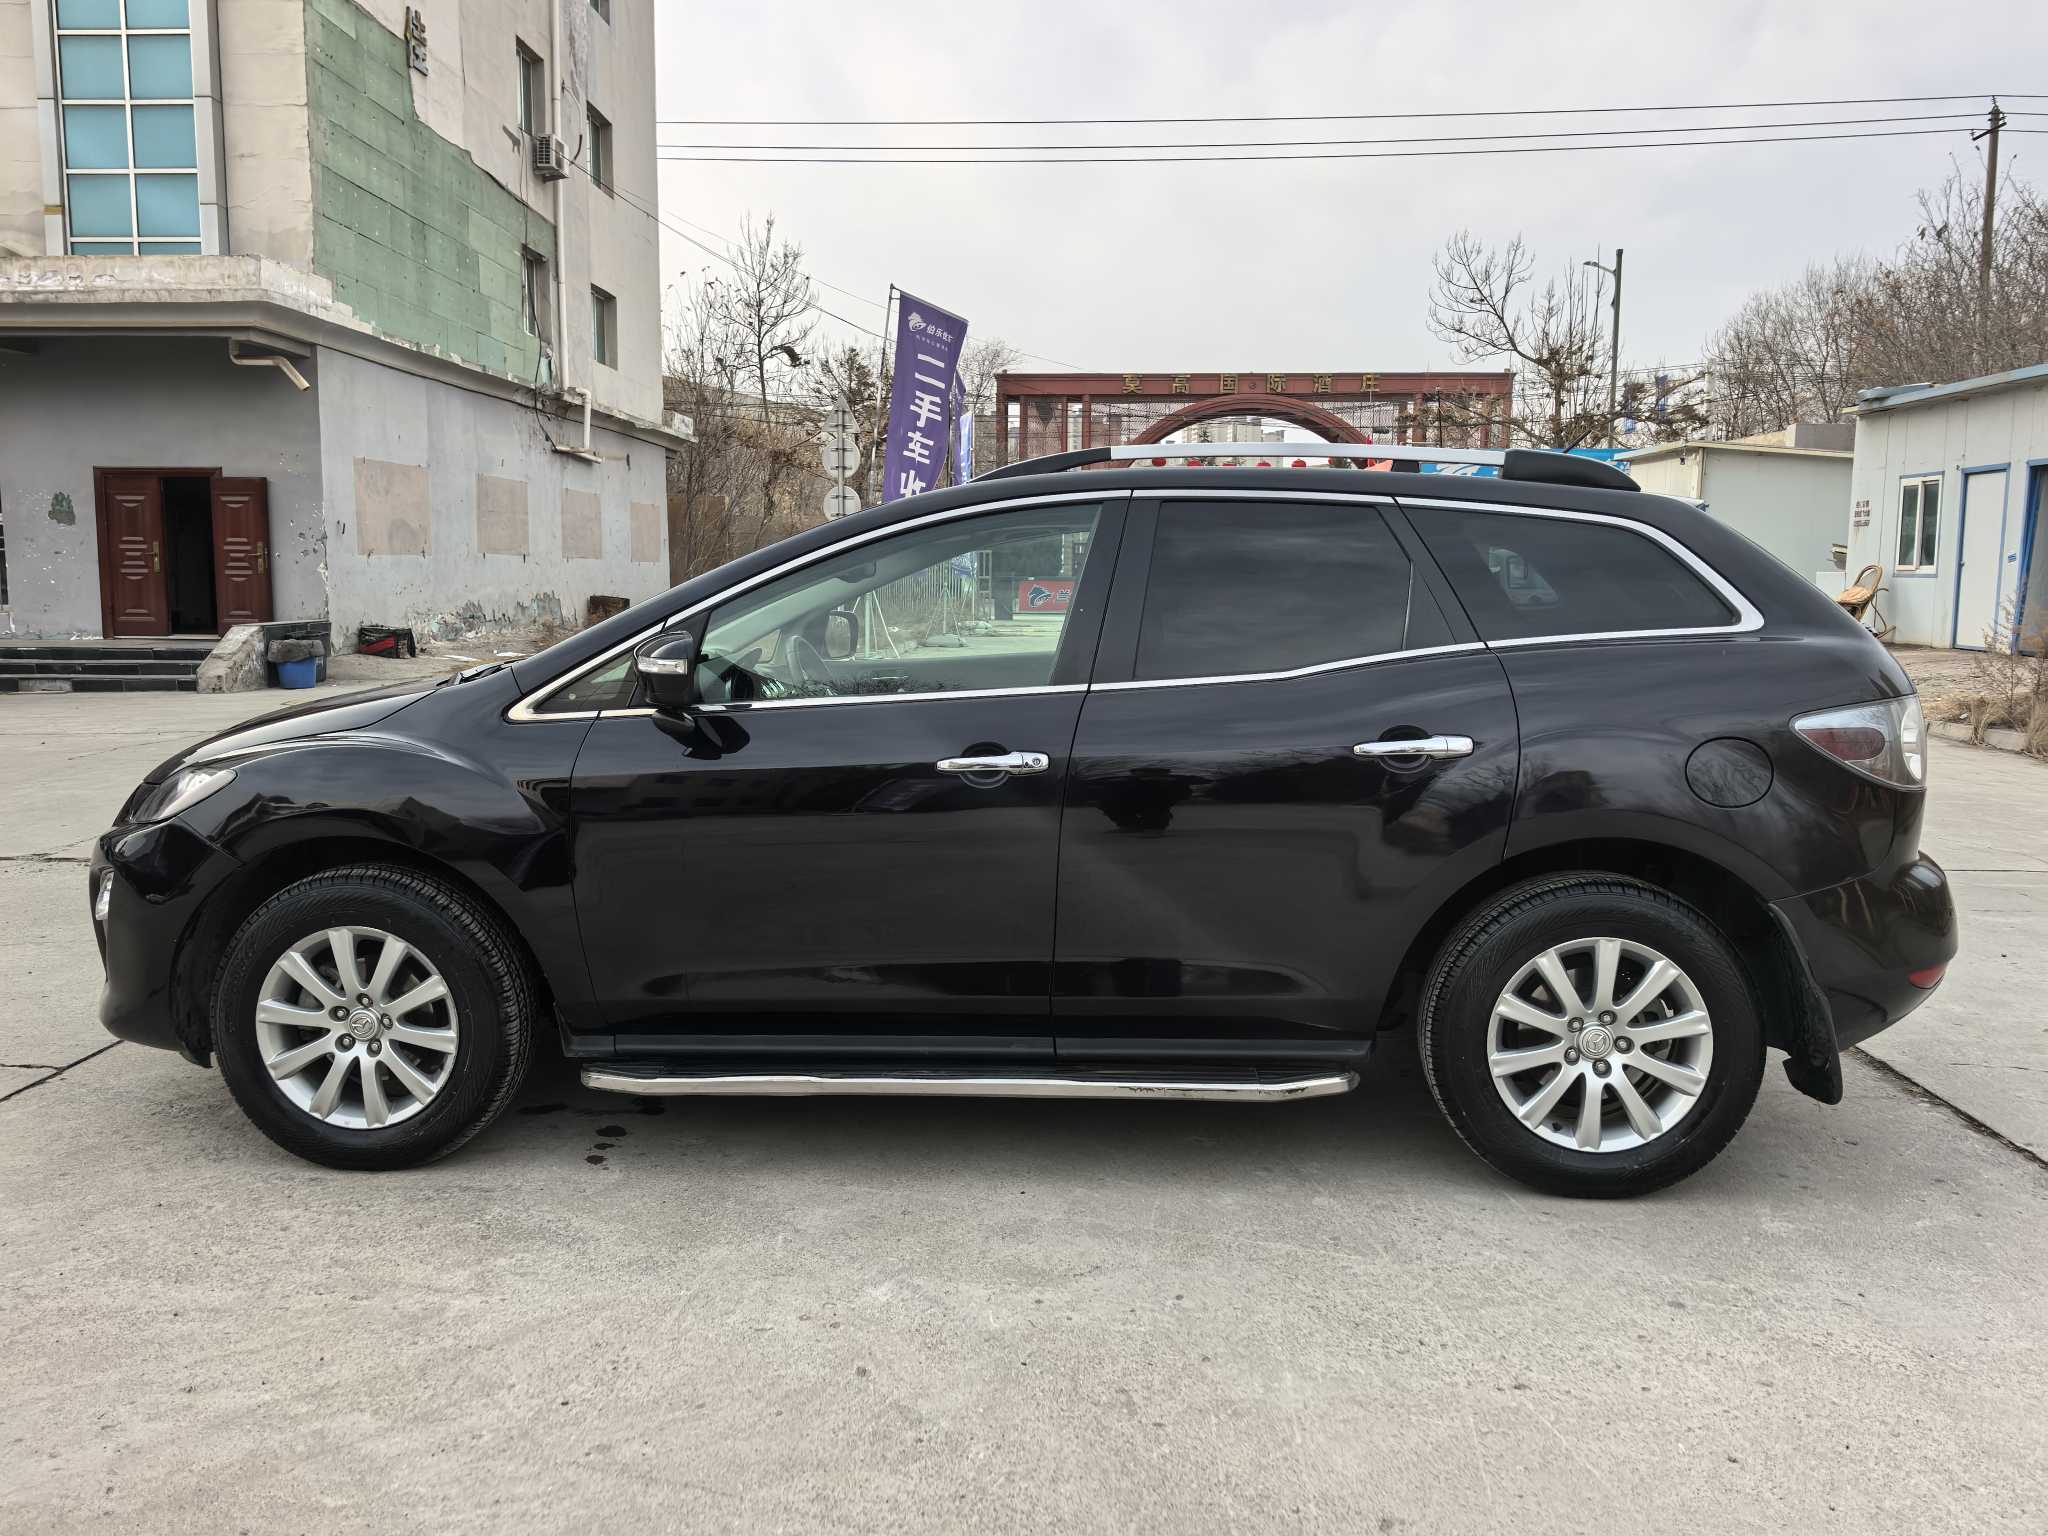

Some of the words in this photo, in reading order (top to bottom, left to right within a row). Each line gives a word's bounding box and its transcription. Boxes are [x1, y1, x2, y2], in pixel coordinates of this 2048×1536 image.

[1122, 372, 1381, 394] 莫高国际酒庄
